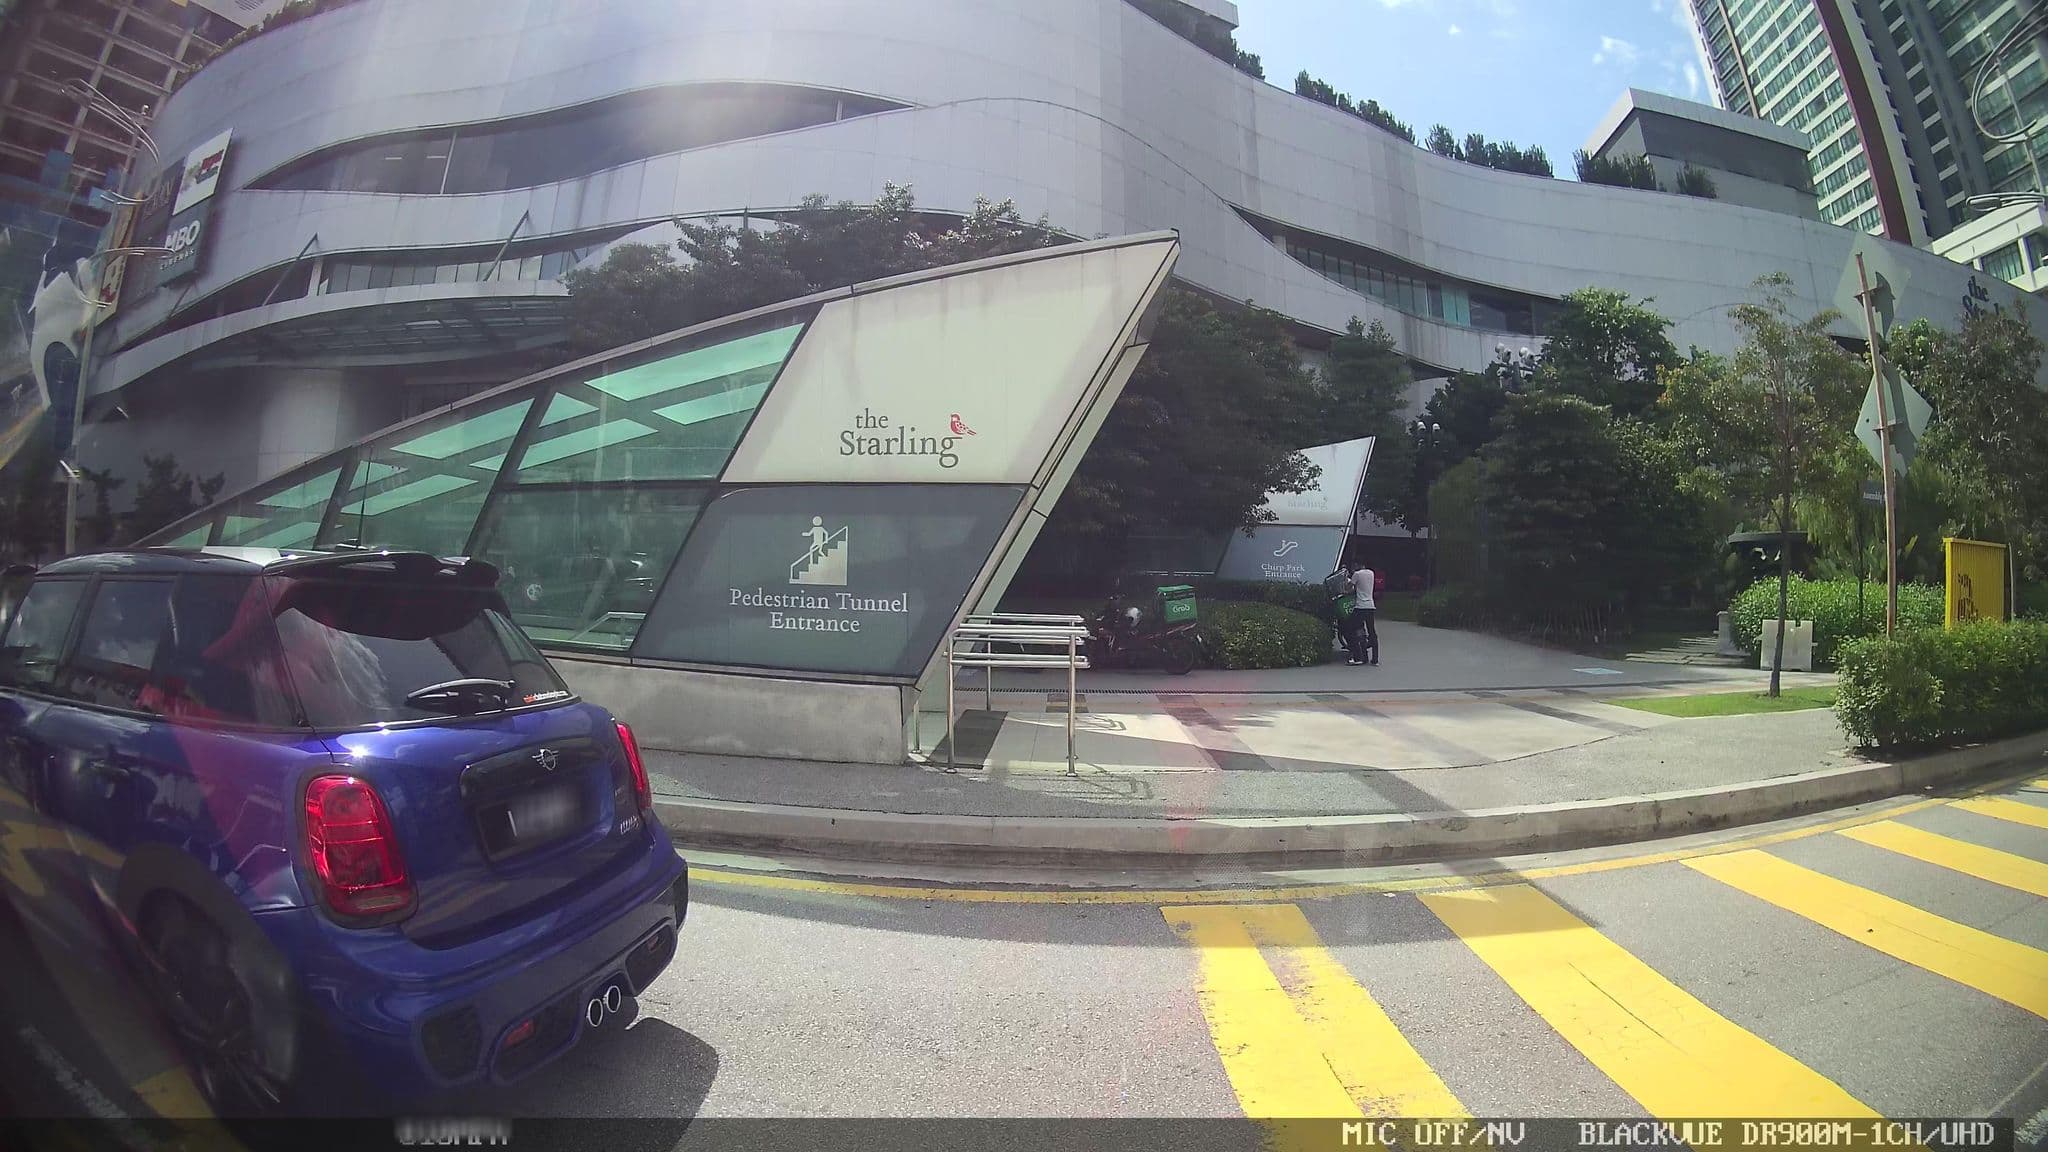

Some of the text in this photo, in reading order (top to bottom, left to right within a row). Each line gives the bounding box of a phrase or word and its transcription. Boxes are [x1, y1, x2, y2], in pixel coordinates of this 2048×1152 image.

[164, 220, 200, 252] MBO
[1968, 275, 1990, 302] the
[856, 408, 888, 429] the
[839, 426, 962, 469] Starling
[1261, 563, 1305, 572] Chirp Park
[1265, 570, 1301, 578] Entrance
[729, 587, 909, 613] Pedestrian Tunnel
[1172, 603, 1190, 613] Grab
[769, 611, 861, 633] Entrance
